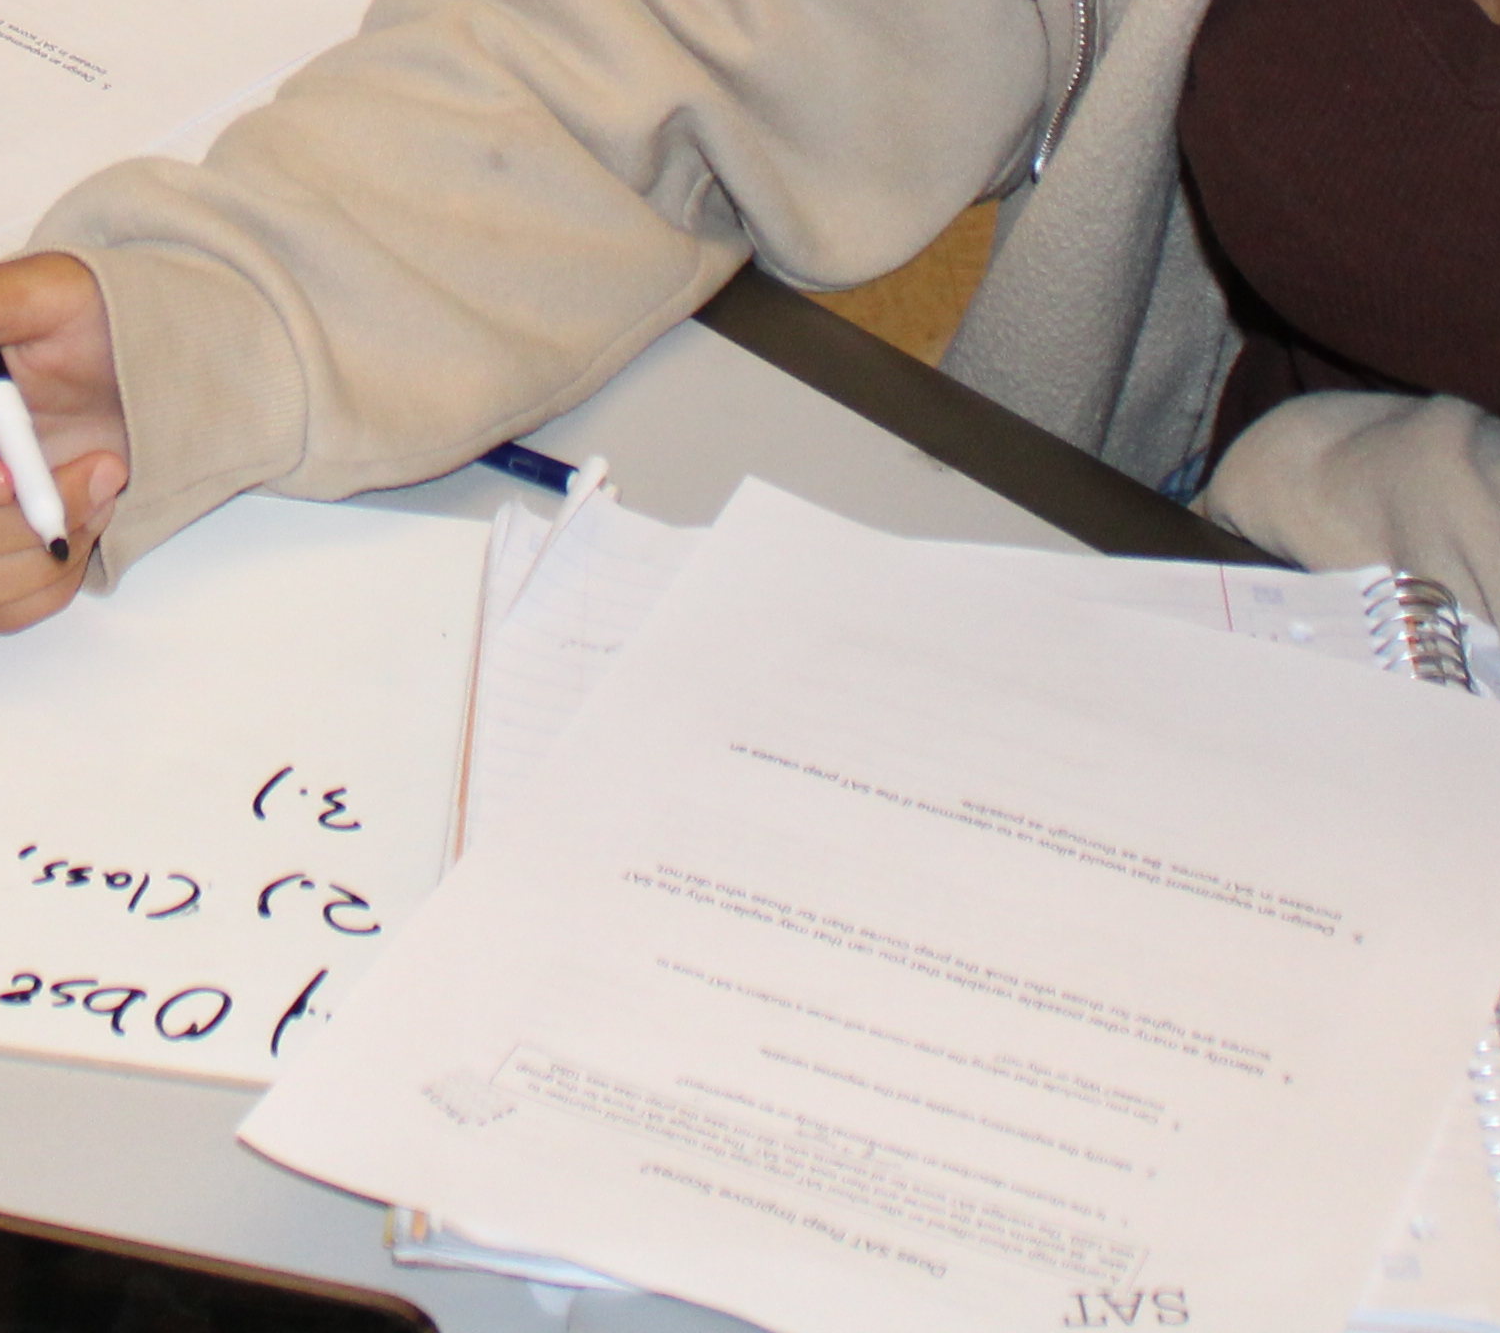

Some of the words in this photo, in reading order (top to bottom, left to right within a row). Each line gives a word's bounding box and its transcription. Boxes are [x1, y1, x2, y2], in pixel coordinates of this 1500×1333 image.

[640, 1164, 713, 1196] Scores?
[718, 1187, 797, 1225] Improve
[802, 1217, 846, 1244] Prep
[852, 1237, 889, 1258] SAT
[897, 1250, 947, 1276] Does
[1063, 1289, 1190, 1327] SAT
